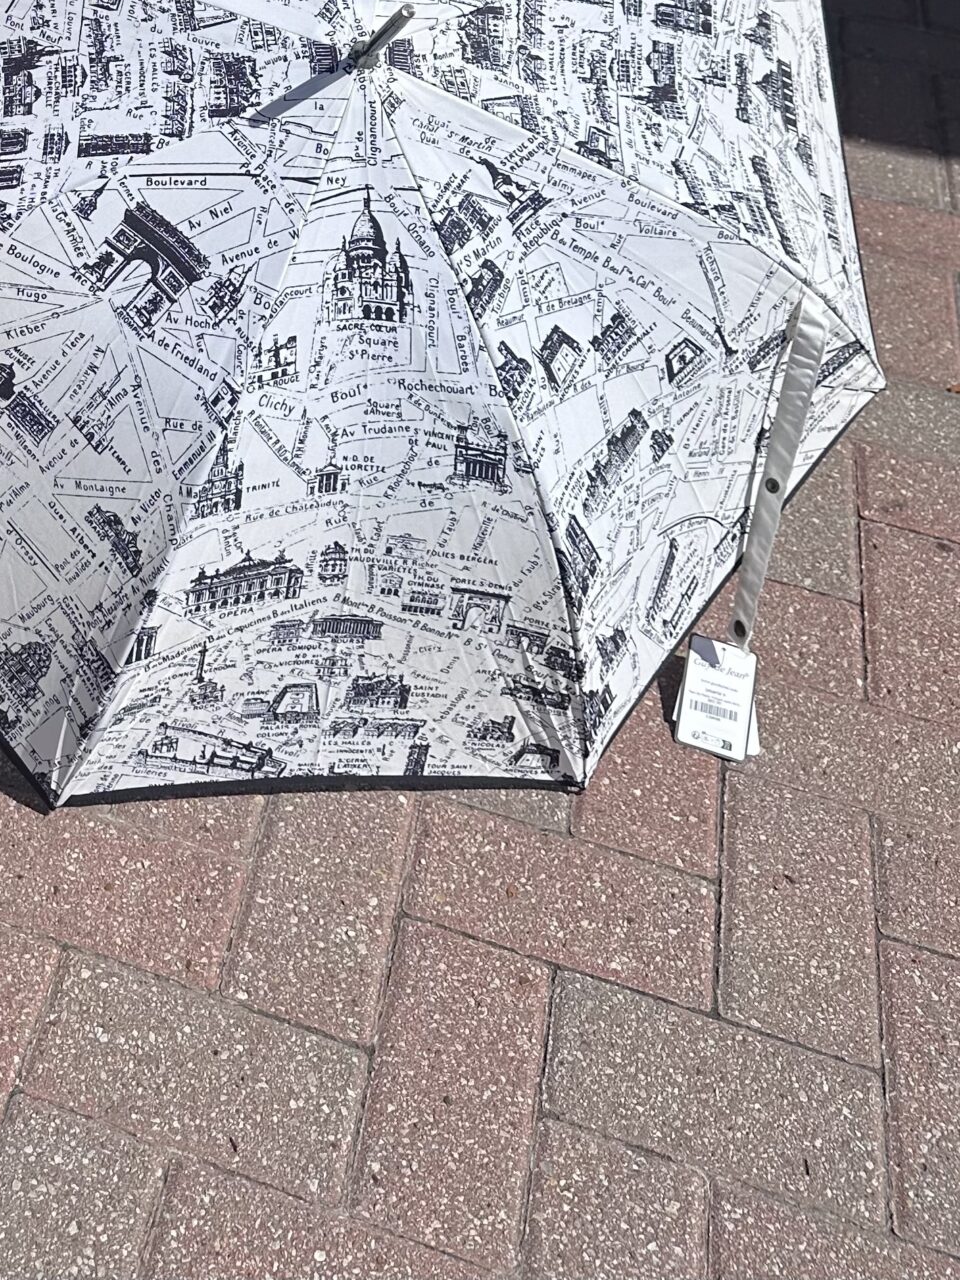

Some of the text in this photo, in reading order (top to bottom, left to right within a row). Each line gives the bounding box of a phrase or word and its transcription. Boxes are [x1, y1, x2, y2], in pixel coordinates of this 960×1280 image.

[367, 100, 381, 166] Clignancourt
[146, 177, 207, 186] Boulevard
[326, 175, 347, 187] Ney
[570, 188, 607, 208] Avenue
[627, 194, 679, 220] Boulevard
[188, 201, 234, 231] Av Niel
[221, 238, 279, 266] Avenue de
[407, 222, 436, 258] Ornano
[568, 239, 600, 263] Temple
[6, 244, 61, 278] Boulogne
[16, 288, 48, 303] Hugo
[165, 311, 179, 324] Av
[32, 359, 61, 390] Avenue
[170, 342, 219, 381] Friedland
[130, 384, 151, 434] Avenue
[258, 393, 295, 417] Clichy
[340, 424, 411, 439] Av Trudaine
[39, 448, 68, 475] Avenue
[75, 480, 127, 493] Montaigne
